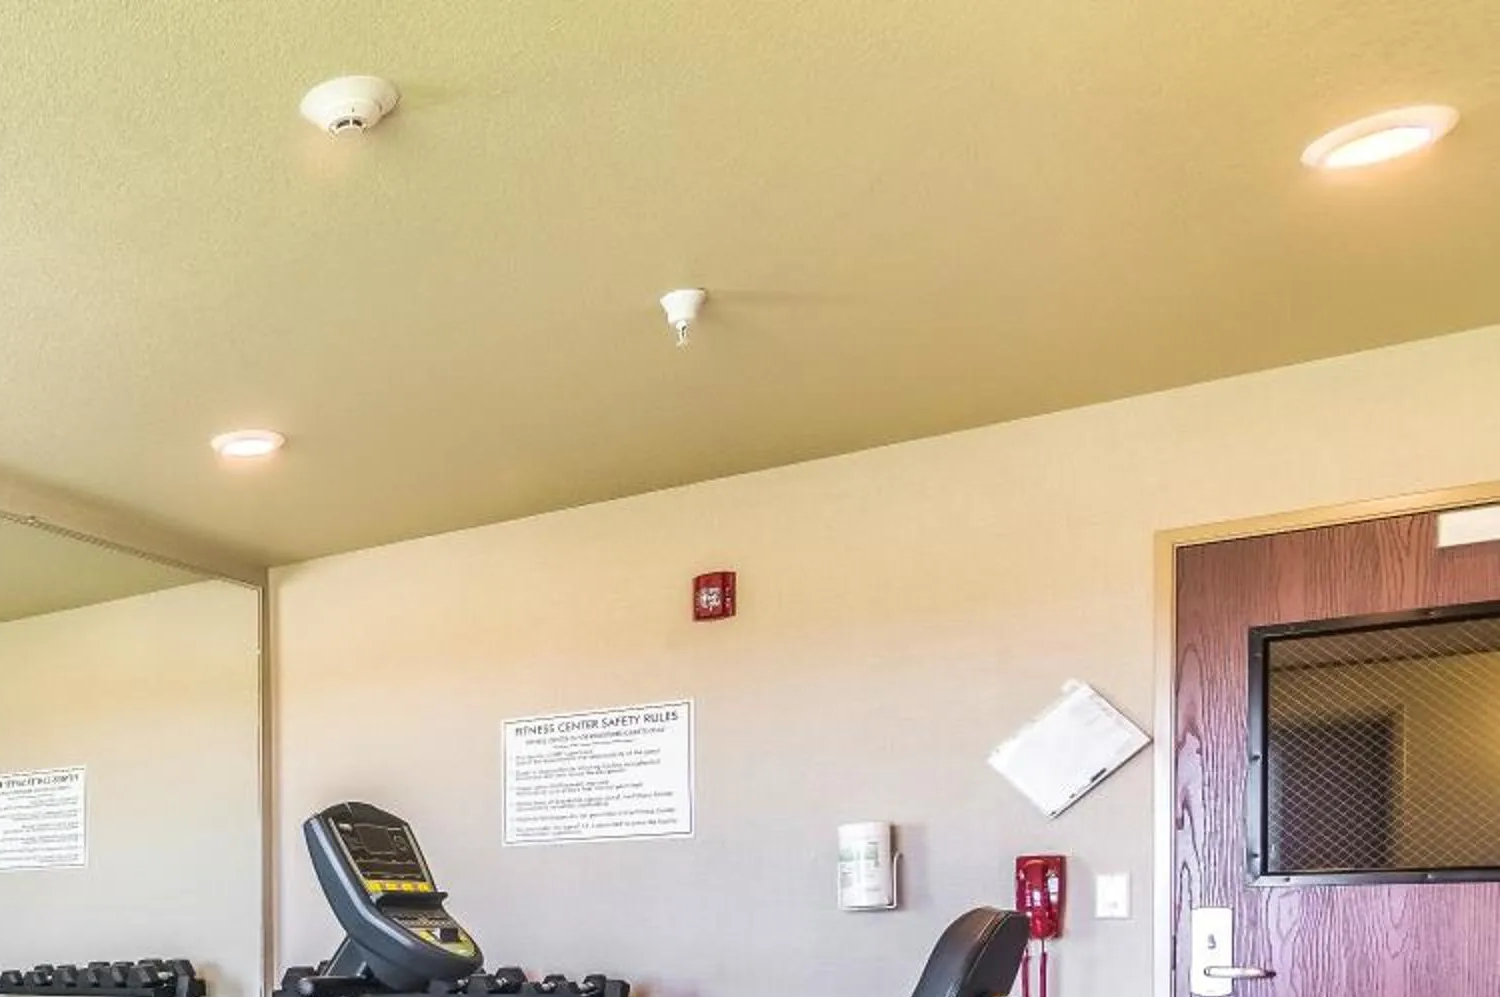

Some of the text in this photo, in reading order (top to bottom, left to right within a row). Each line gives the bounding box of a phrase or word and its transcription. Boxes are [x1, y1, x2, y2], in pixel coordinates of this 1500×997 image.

[515, 723, 556, 737] FITNESS
[557, 719, 599, 733] CENTER
[601, 714, 641, 729] SAFETY
[643, 710, 679, 724] RULES
